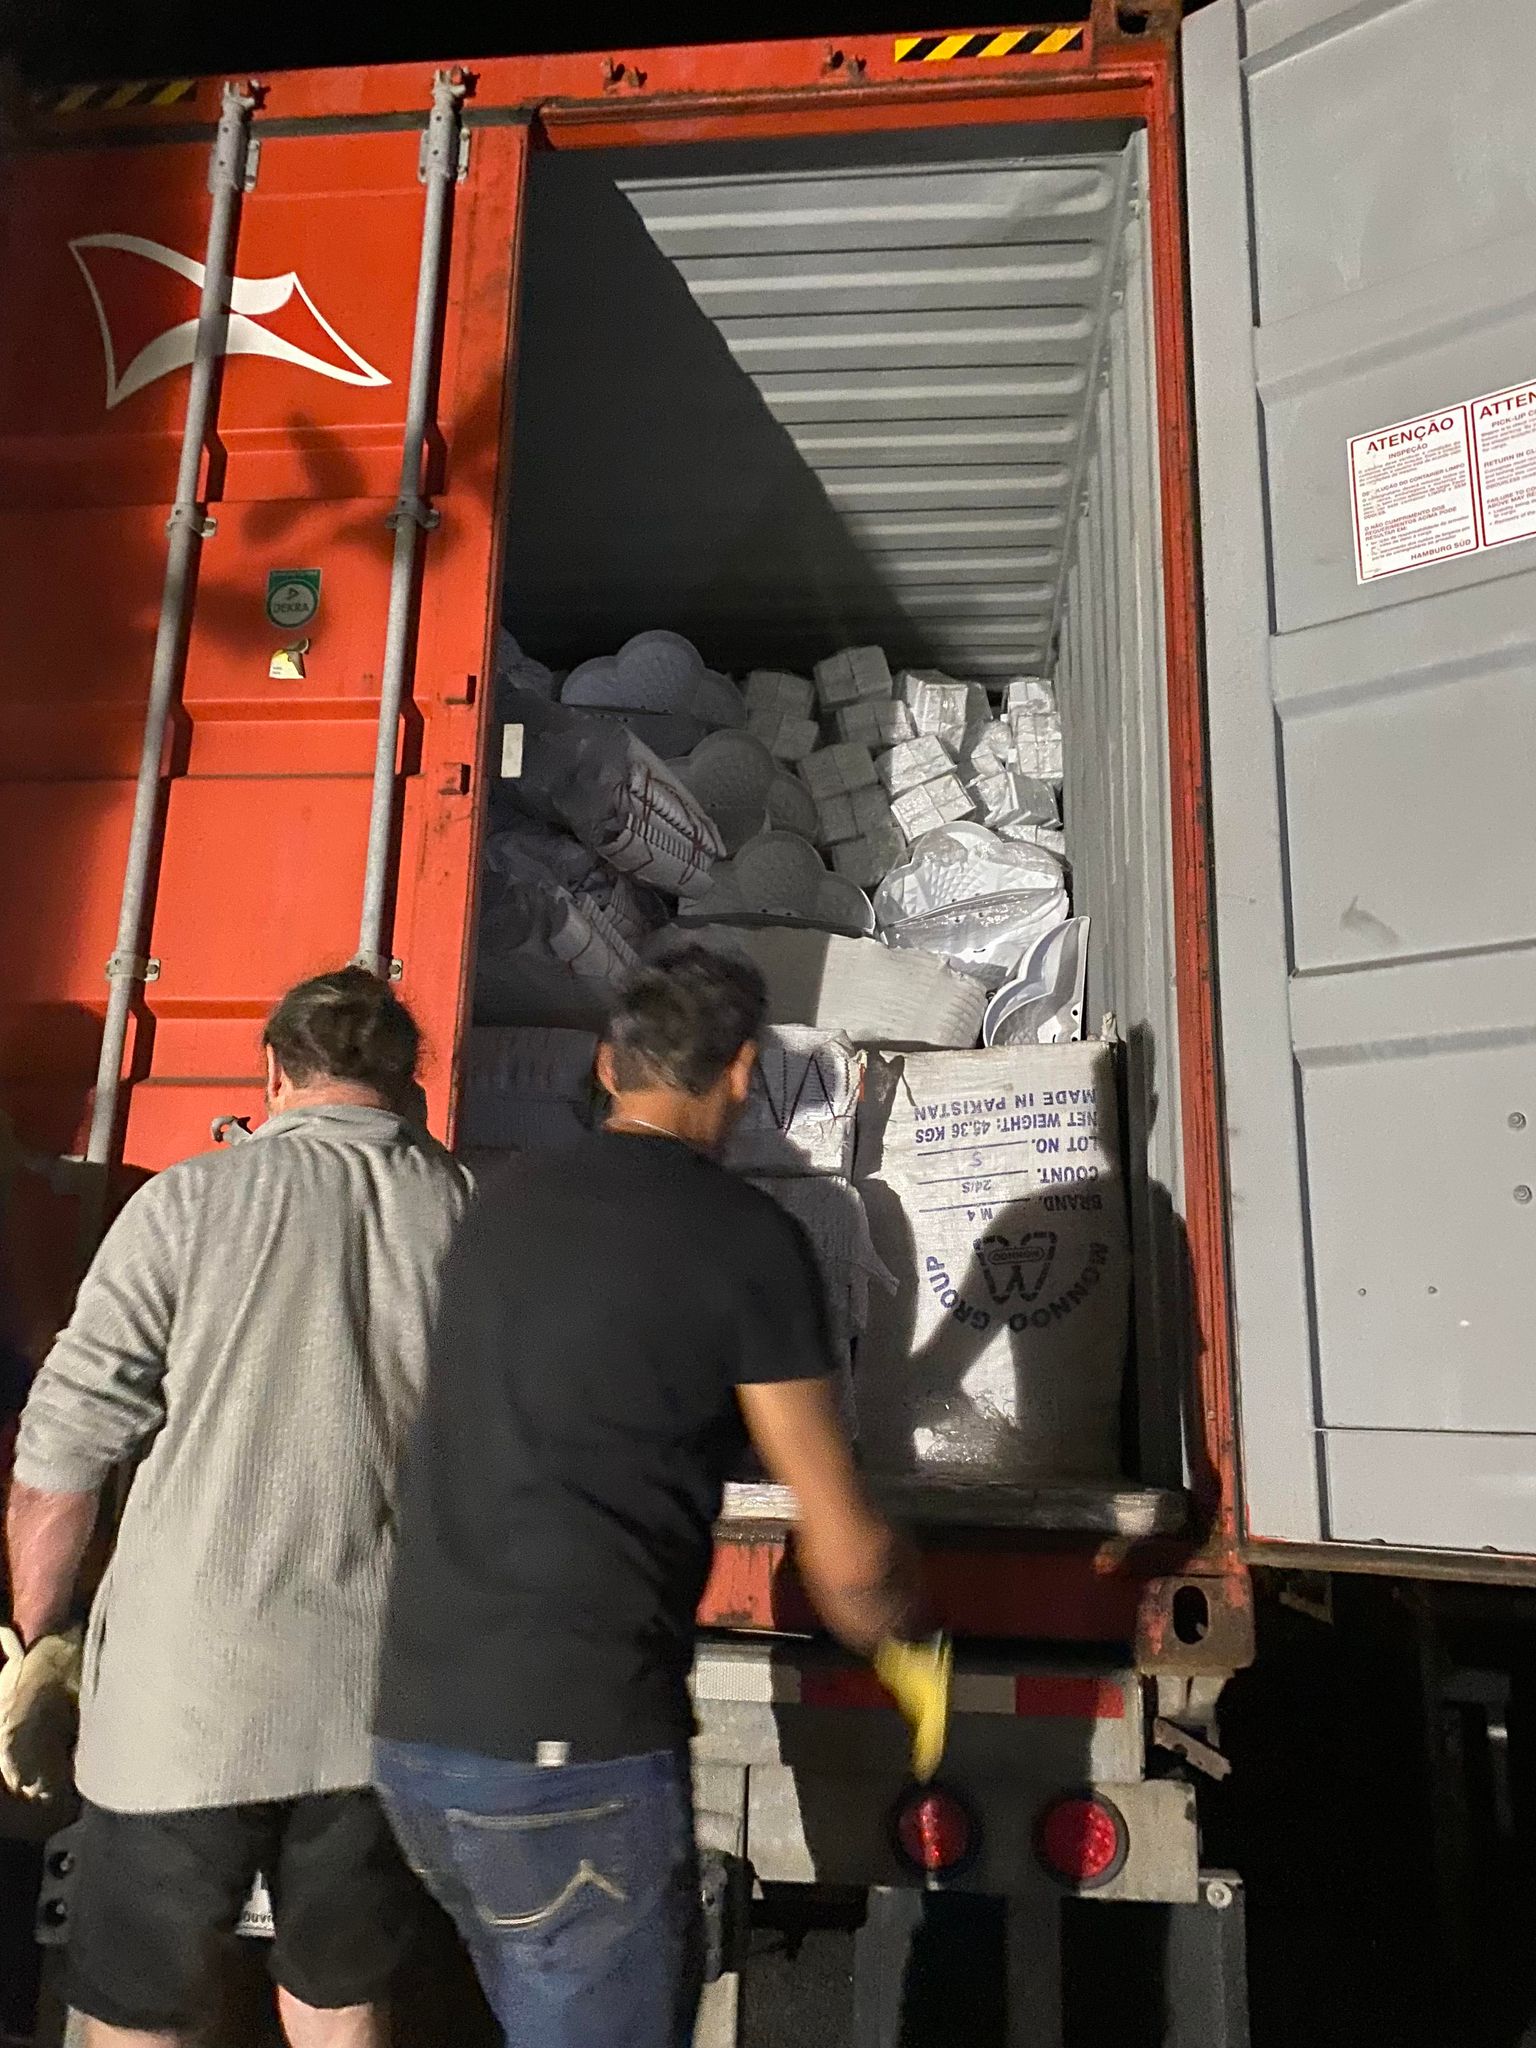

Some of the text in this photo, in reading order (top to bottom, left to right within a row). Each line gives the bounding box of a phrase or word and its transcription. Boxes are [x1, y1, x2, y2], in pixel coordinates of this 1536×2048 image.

[1366, 417, 1454, 454] ATENÇÃO
[1388, 442, 1427, 459] INSPEÇÃO
[1410, 543, 1452, 560] HAMBURG
[914, 1088, 1096, 1121] MADE IN PAKISTAN
[915, 1111, 1098, 1144] NET WEIGHT: 45.36 KGS
[1031, 1138, 1060, 1154] NO.
[1067, 1135, 1098, 1152] LOT
[1037, 1165, 1099, 1184] COUNT.
[1039, 1194, 1104, 1212] BRAND.
[925, 1256, 991, 1331] GROUP
